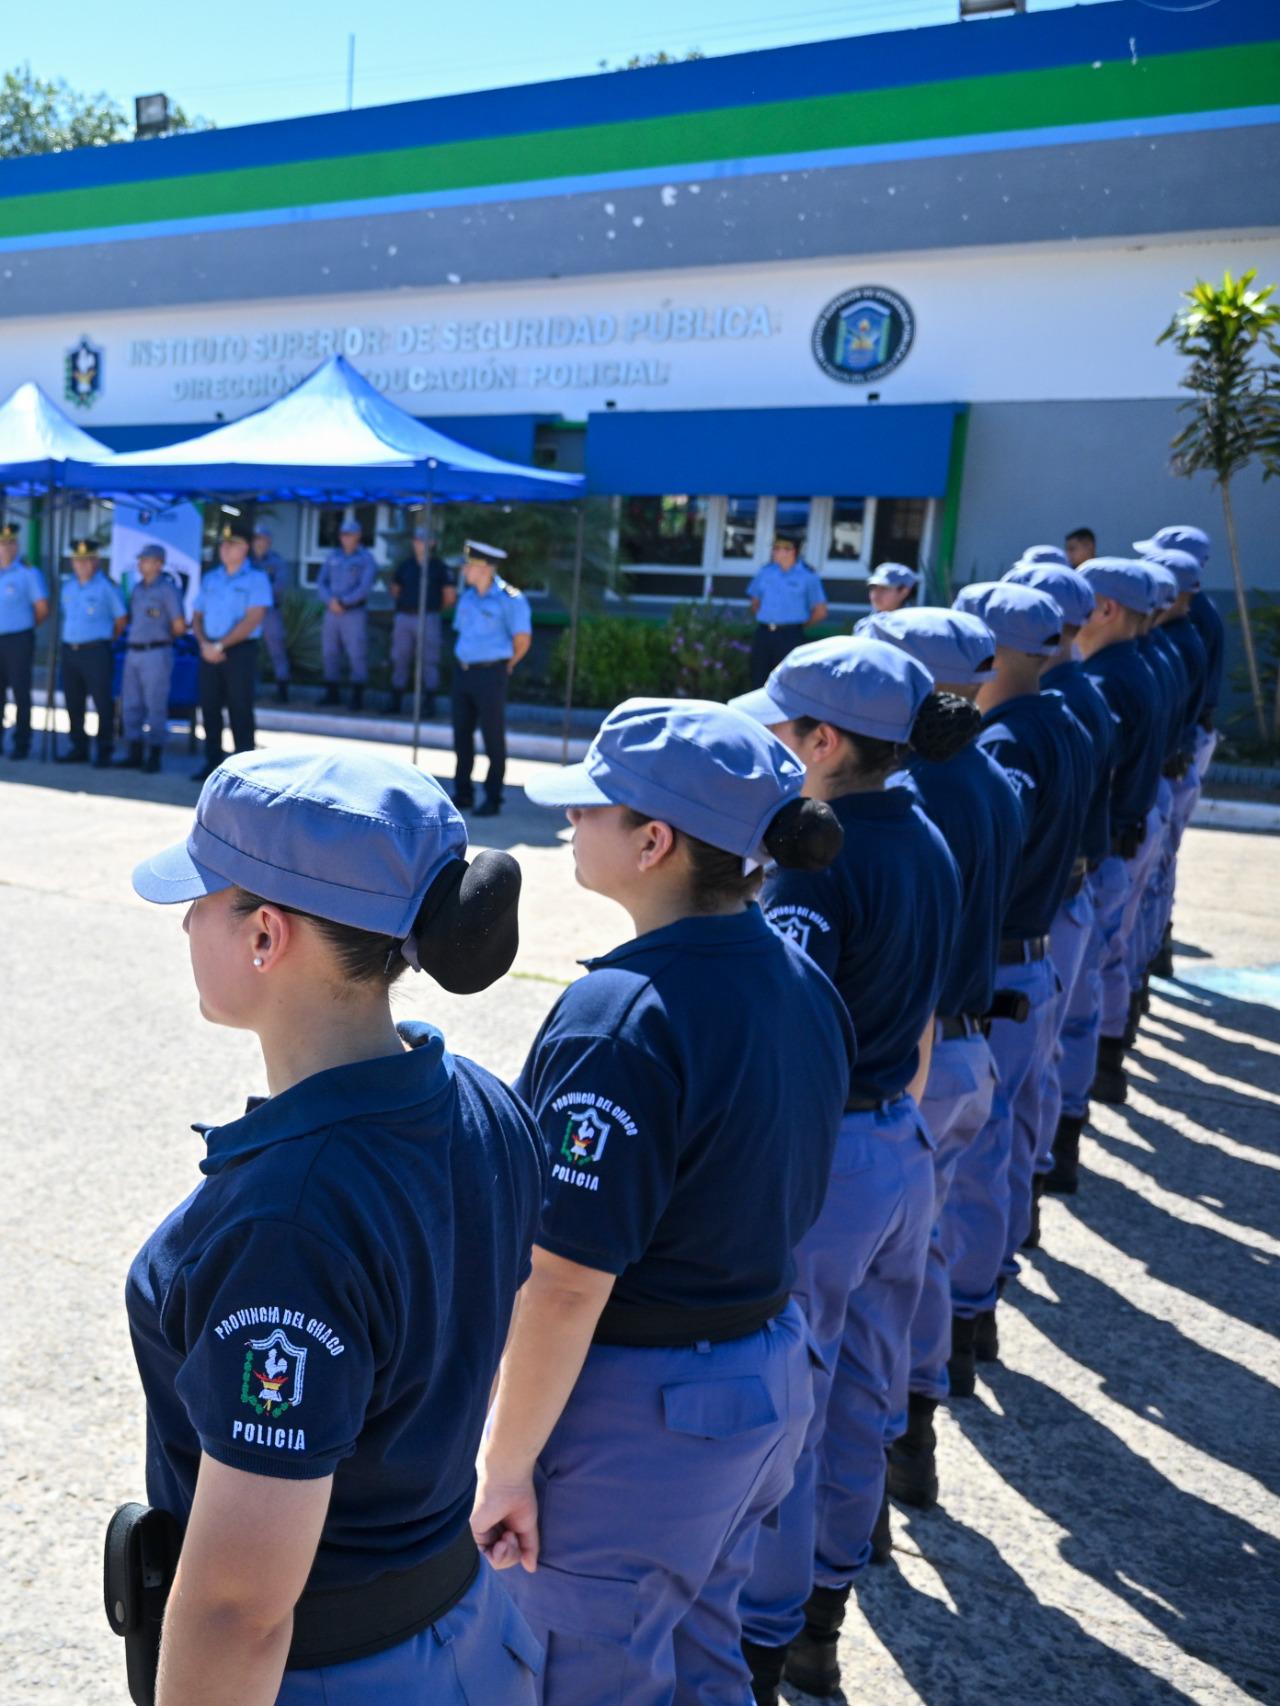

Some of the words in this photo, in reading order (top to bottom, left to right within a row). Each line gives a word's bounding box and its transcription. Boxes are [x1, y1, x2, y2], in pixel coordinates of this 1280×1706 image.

[128, 334, 247, 367] INSTITUTO
[251, 325, 386, 361] SUPERIOR
[396, 322, 434, 354] DE
[440, 310, 616, 353] SEGURIDAD
[365, 357, 517, 393] DUCACIÓN
[527, 359, 669, 390] POLICIAL
[551, 1092, 596, 1112] PROVINCIA
[595, 1096, 613, 1112] DEL
[611, 1106, 638, 1136] CHACO
[551, 1163, 600, 1191] POLICIA
[214, 1306, 280, 1340] PROVINCIA
[282, 1309, 305, 1330] DEL
[305, 1318, 345, 1356] CHACO
[231, 1419, 306, 1450] POLICIA
